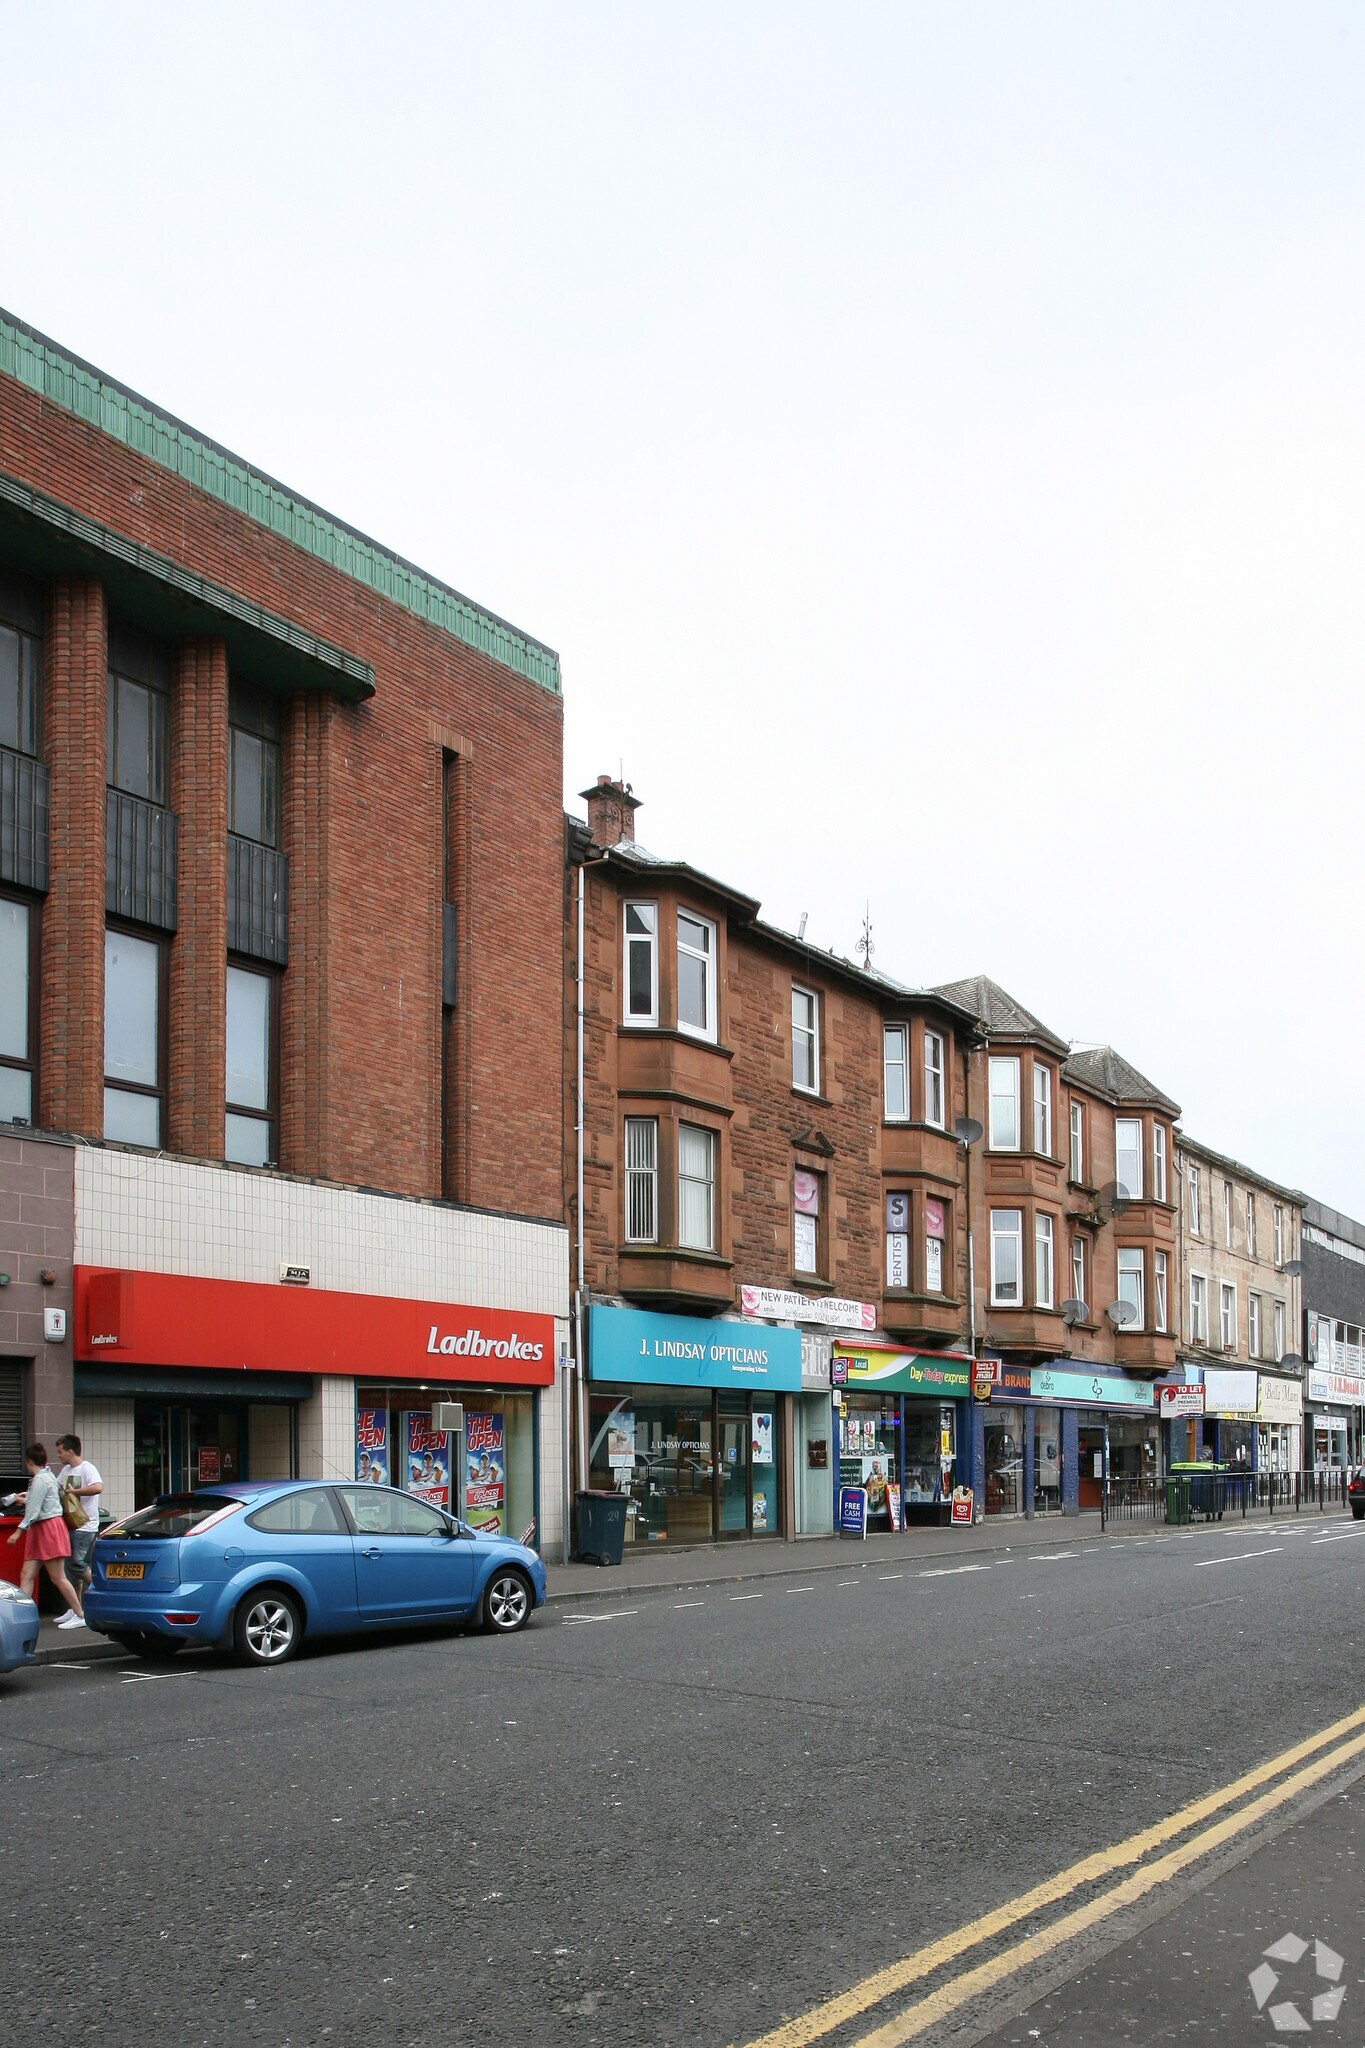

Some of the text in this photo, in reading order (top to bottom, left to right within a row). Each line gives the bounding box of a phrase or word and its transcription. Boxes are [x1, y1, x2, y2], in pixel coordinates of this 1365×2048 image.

[893, 1233, 902, 1287] DENTIST
[761, 1291, 782, 1303] NEW
[823, 1300, 859, 1314] WELCOME
[91, 1334, 118, 1344] Ladbrokes
[427, 1325, 544, 1361] Ladbrokes
[640, 1338, 768, 1365] J. LINDSAY OPTICIANS
[855, 1359, 867, 1369] Local
[944, 1373, 969, 1386] express
[976, 1371, 993, 1379] mail
[1189, 1385, 1203, 1393] LET
[468, 1415, 494, 1435] THE
[357, 1427, 386, 1448] PEN
[409, 1431, 449, 1453] OPEN
[467, 1430, 503, 1452] OPEN
[657, 1441, 681, 1449] LINDSAY
[682, 1441, 710, 1450] OPTICIANS
[844, 1502, 861, 1510] FREE
[608, 1510, 620, 1522] 29
[123, 1565, 142, 1577] 8669
